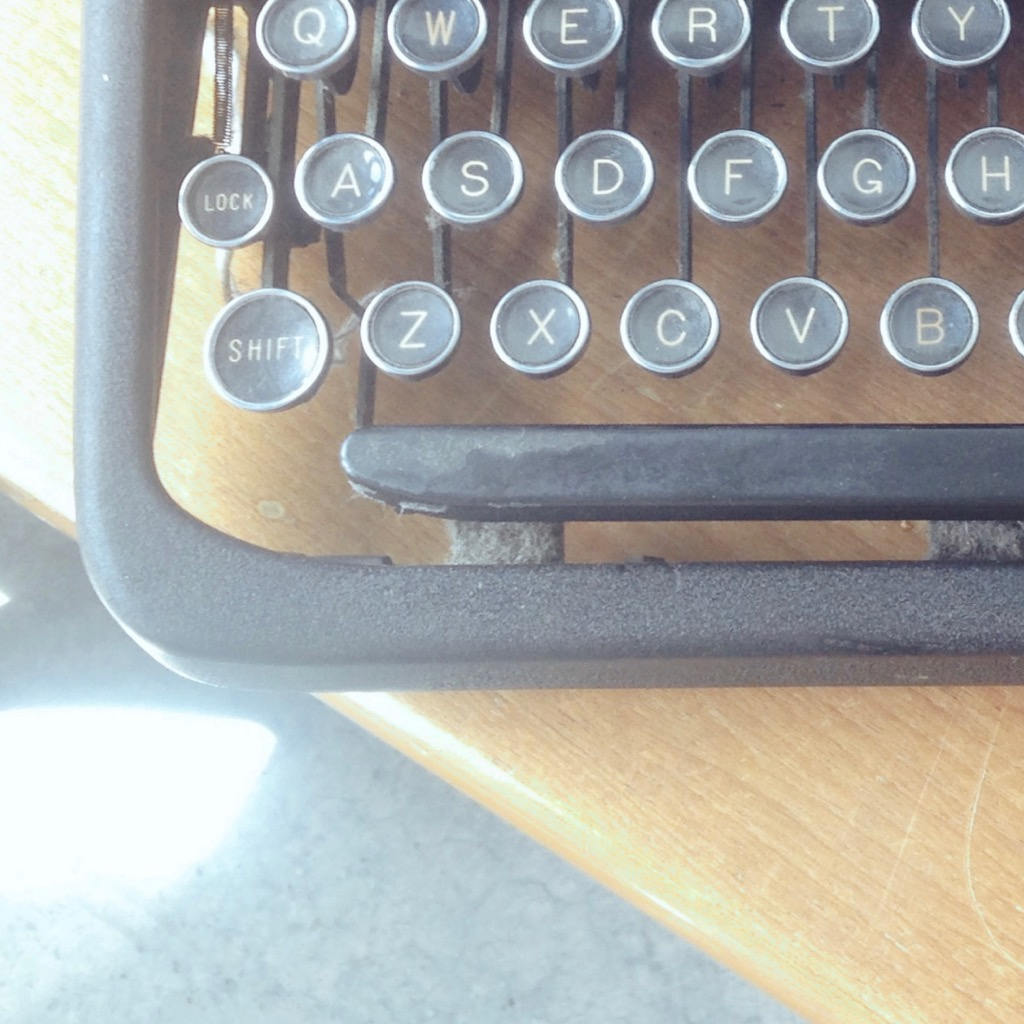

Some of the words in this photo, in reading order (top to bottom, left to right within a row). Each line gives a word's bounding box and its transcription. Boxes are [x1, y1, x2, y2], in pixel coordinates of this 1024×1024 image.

[293, 7, 327, 47] Q
[424, 9, 457, 47] W
[560, 7, 589, 45] E
[688, 7, 717, 43] R
[817, 5, 845, 43] T
[947, 5, 975, 42] Y
[330, 162, 362, 198] A
[460, 160, 490, 197] S
[592, 158, 625, 196] D
[724, 158, 754, 196] F
[852, 157, 883, 195] G
[981, 155, 1011, 193] H
[204, 192, 253, 213] LOCK
[399, 310, 428, 349] Z
[527, 308, 556, 345] X
[656, 308, 687, 347] C
[785, 306, 816, 344] V
[916, 307, 945, 346] B
[228, 336, 305, 363] SHIFT
